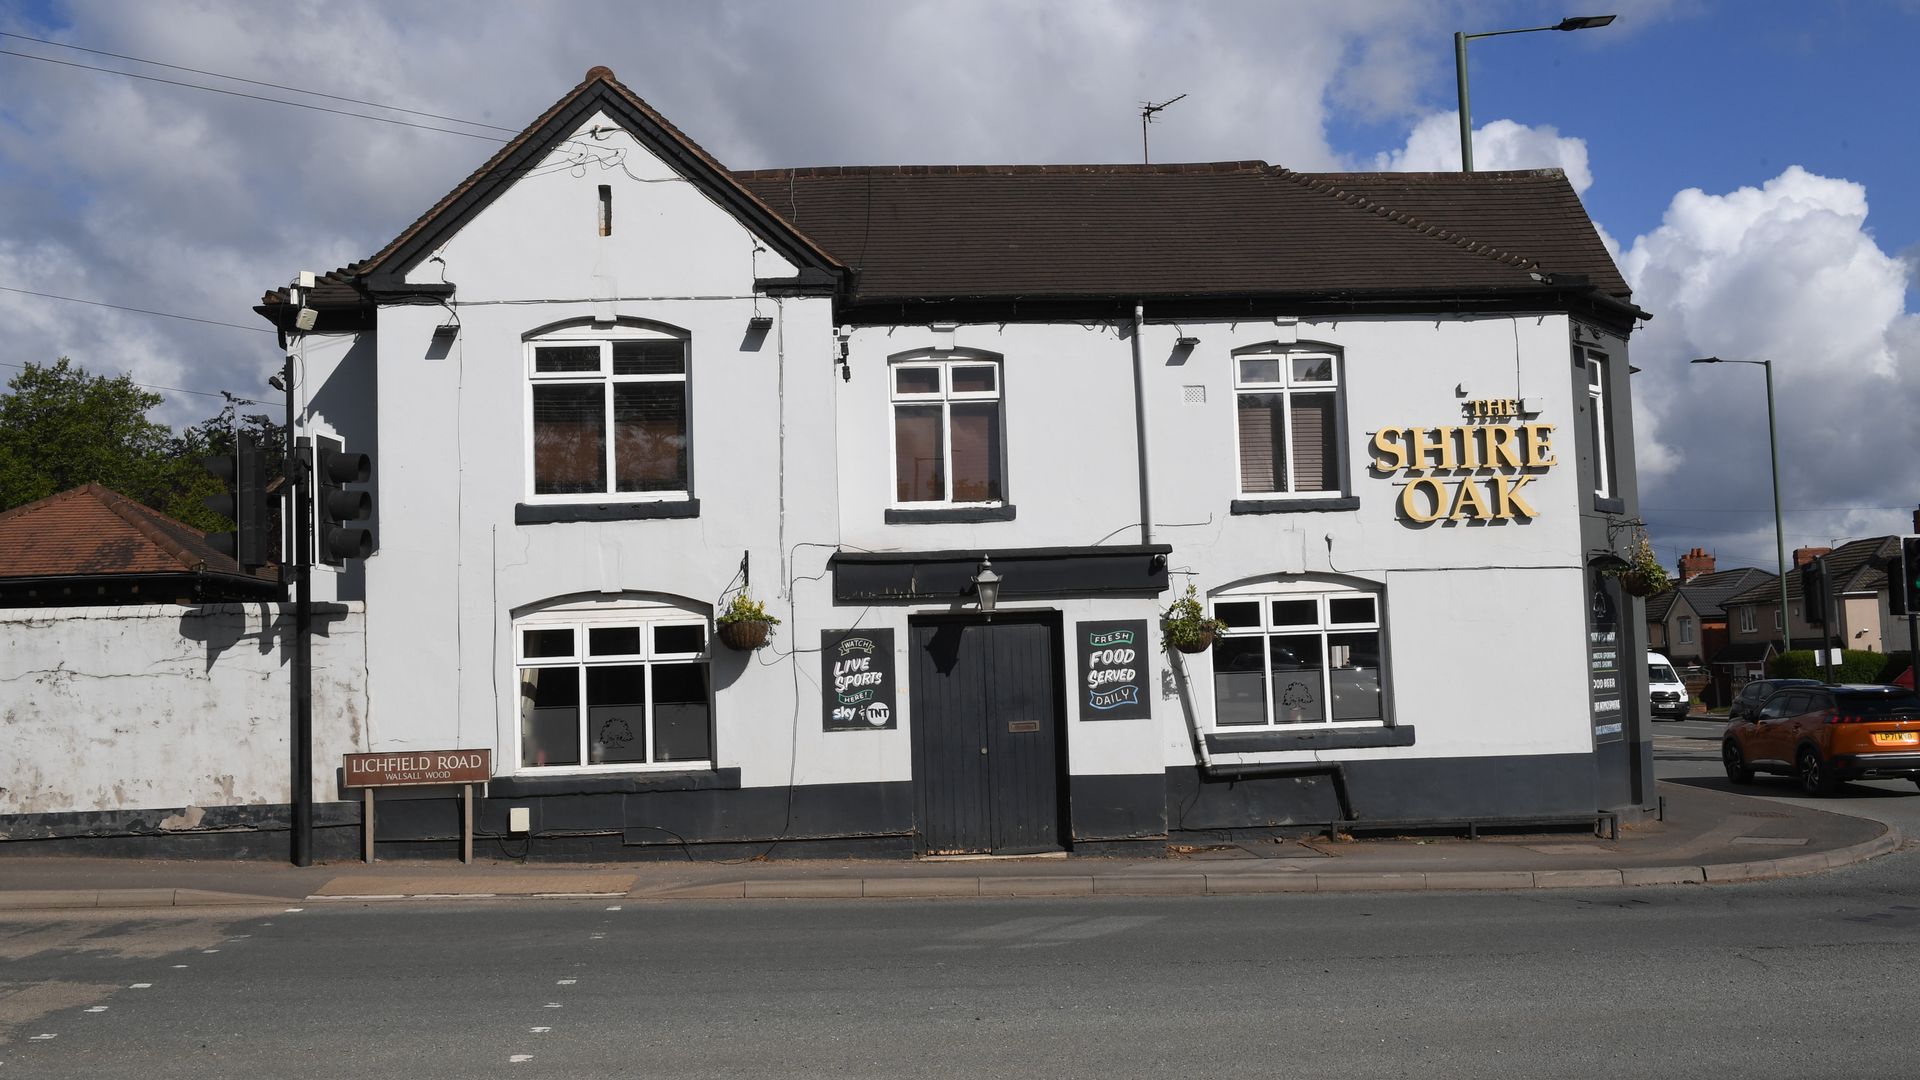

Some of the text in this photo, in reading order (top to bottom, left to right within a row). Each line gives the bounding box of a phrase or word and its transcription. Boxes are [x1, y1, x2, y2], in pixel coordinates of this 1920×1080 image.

[1468, 399, 1520, 417] THE
[1374, 423, 1558, 472] SHIRE
[1403, 475, 1541, 522] OAK
[844, 639, 869, 649] WATCH
[1094, 633, 1129, 643] FRESH
[834, 657, 871, 677] LIVE
[1089, 649, 1135, 669] FOOD
[835, 672, 883, 693] SPORTS
[1088, 669, 1136, 689] SERVED
[844, 692, 868, 703] HERE!
[1096, 689, 1130, 706] DAILY
[832, 705, 857, 721] sky
[868, 708, 889, 718] TNT
[353, 755, 482, 773] LICHFIELD ROAD
[385, 771, 451, 780] WALSALL WOOD
